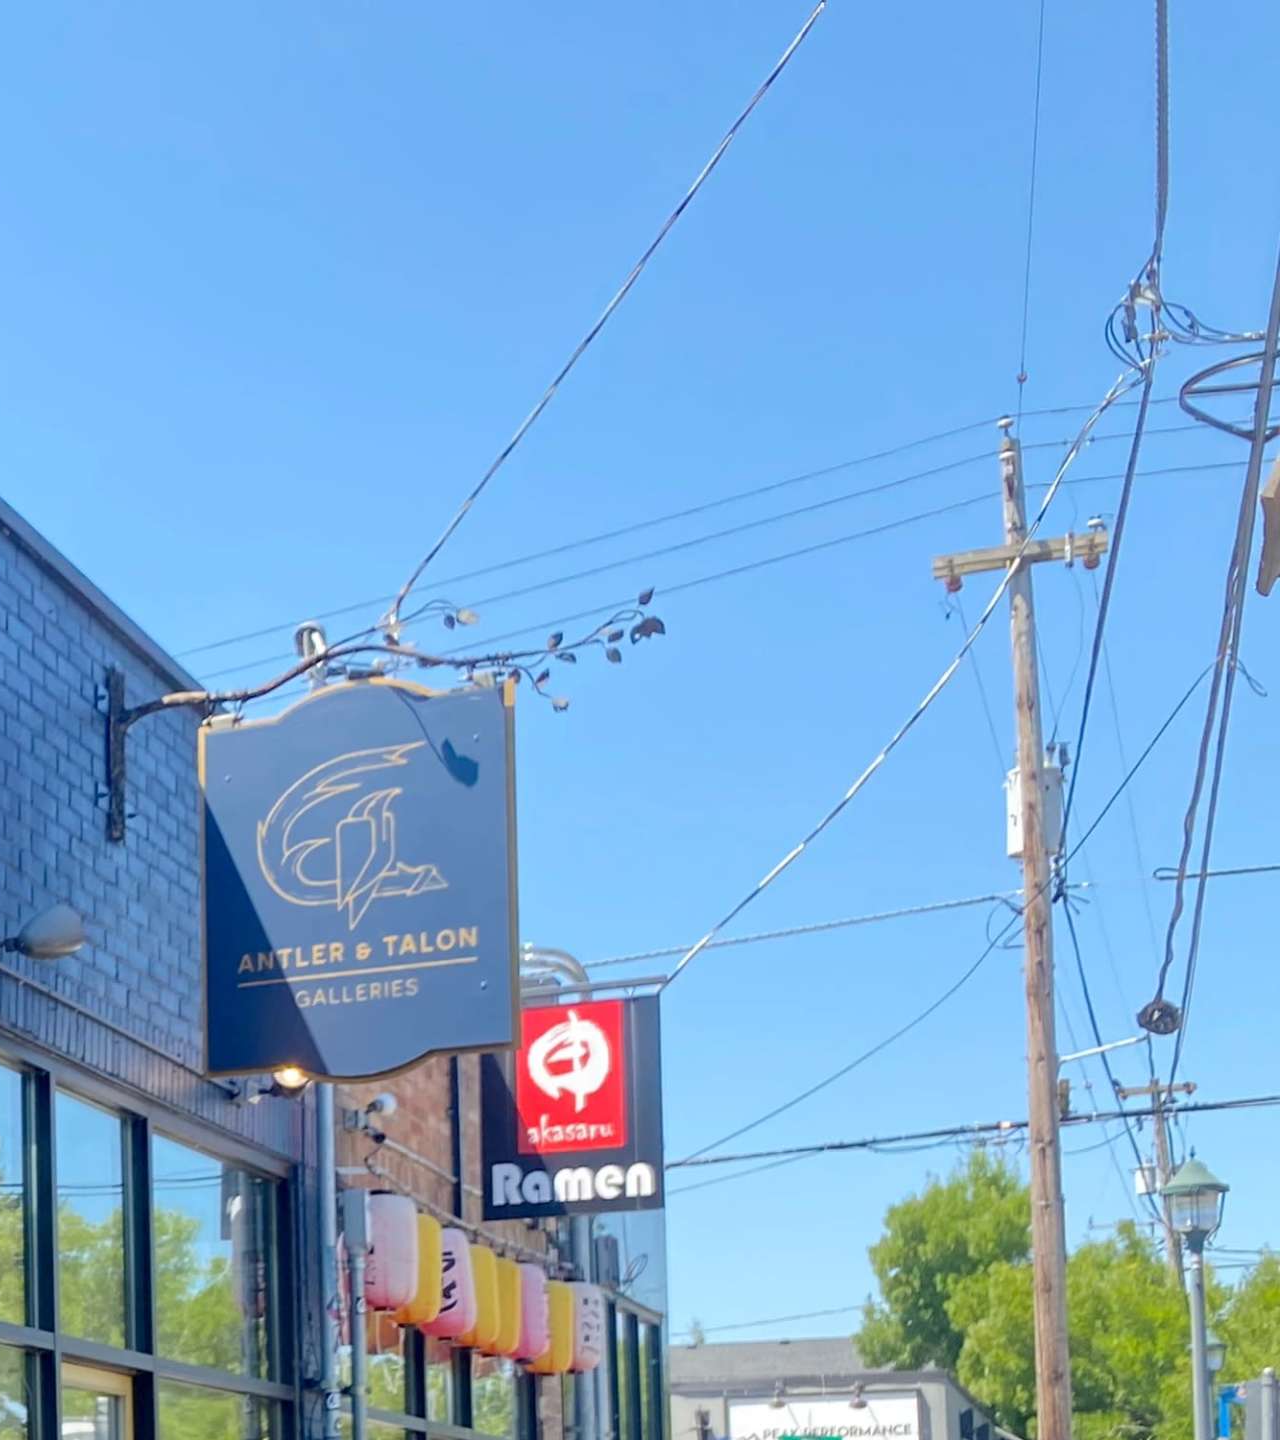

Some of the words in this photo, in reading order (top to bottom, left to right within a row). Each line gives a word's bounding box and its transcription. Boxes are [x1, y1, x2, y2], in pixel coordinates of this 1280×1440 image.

[237, 942, 345, 974] ANTLER
[355, 943, 372, 961] &
[382, 926, 479, 957] TALON
[295, 977, 419, 1008] GALLERIES
[527, 1113, 614, 1145] akasaru
[492, 1162, 656, 1207] Ramen
